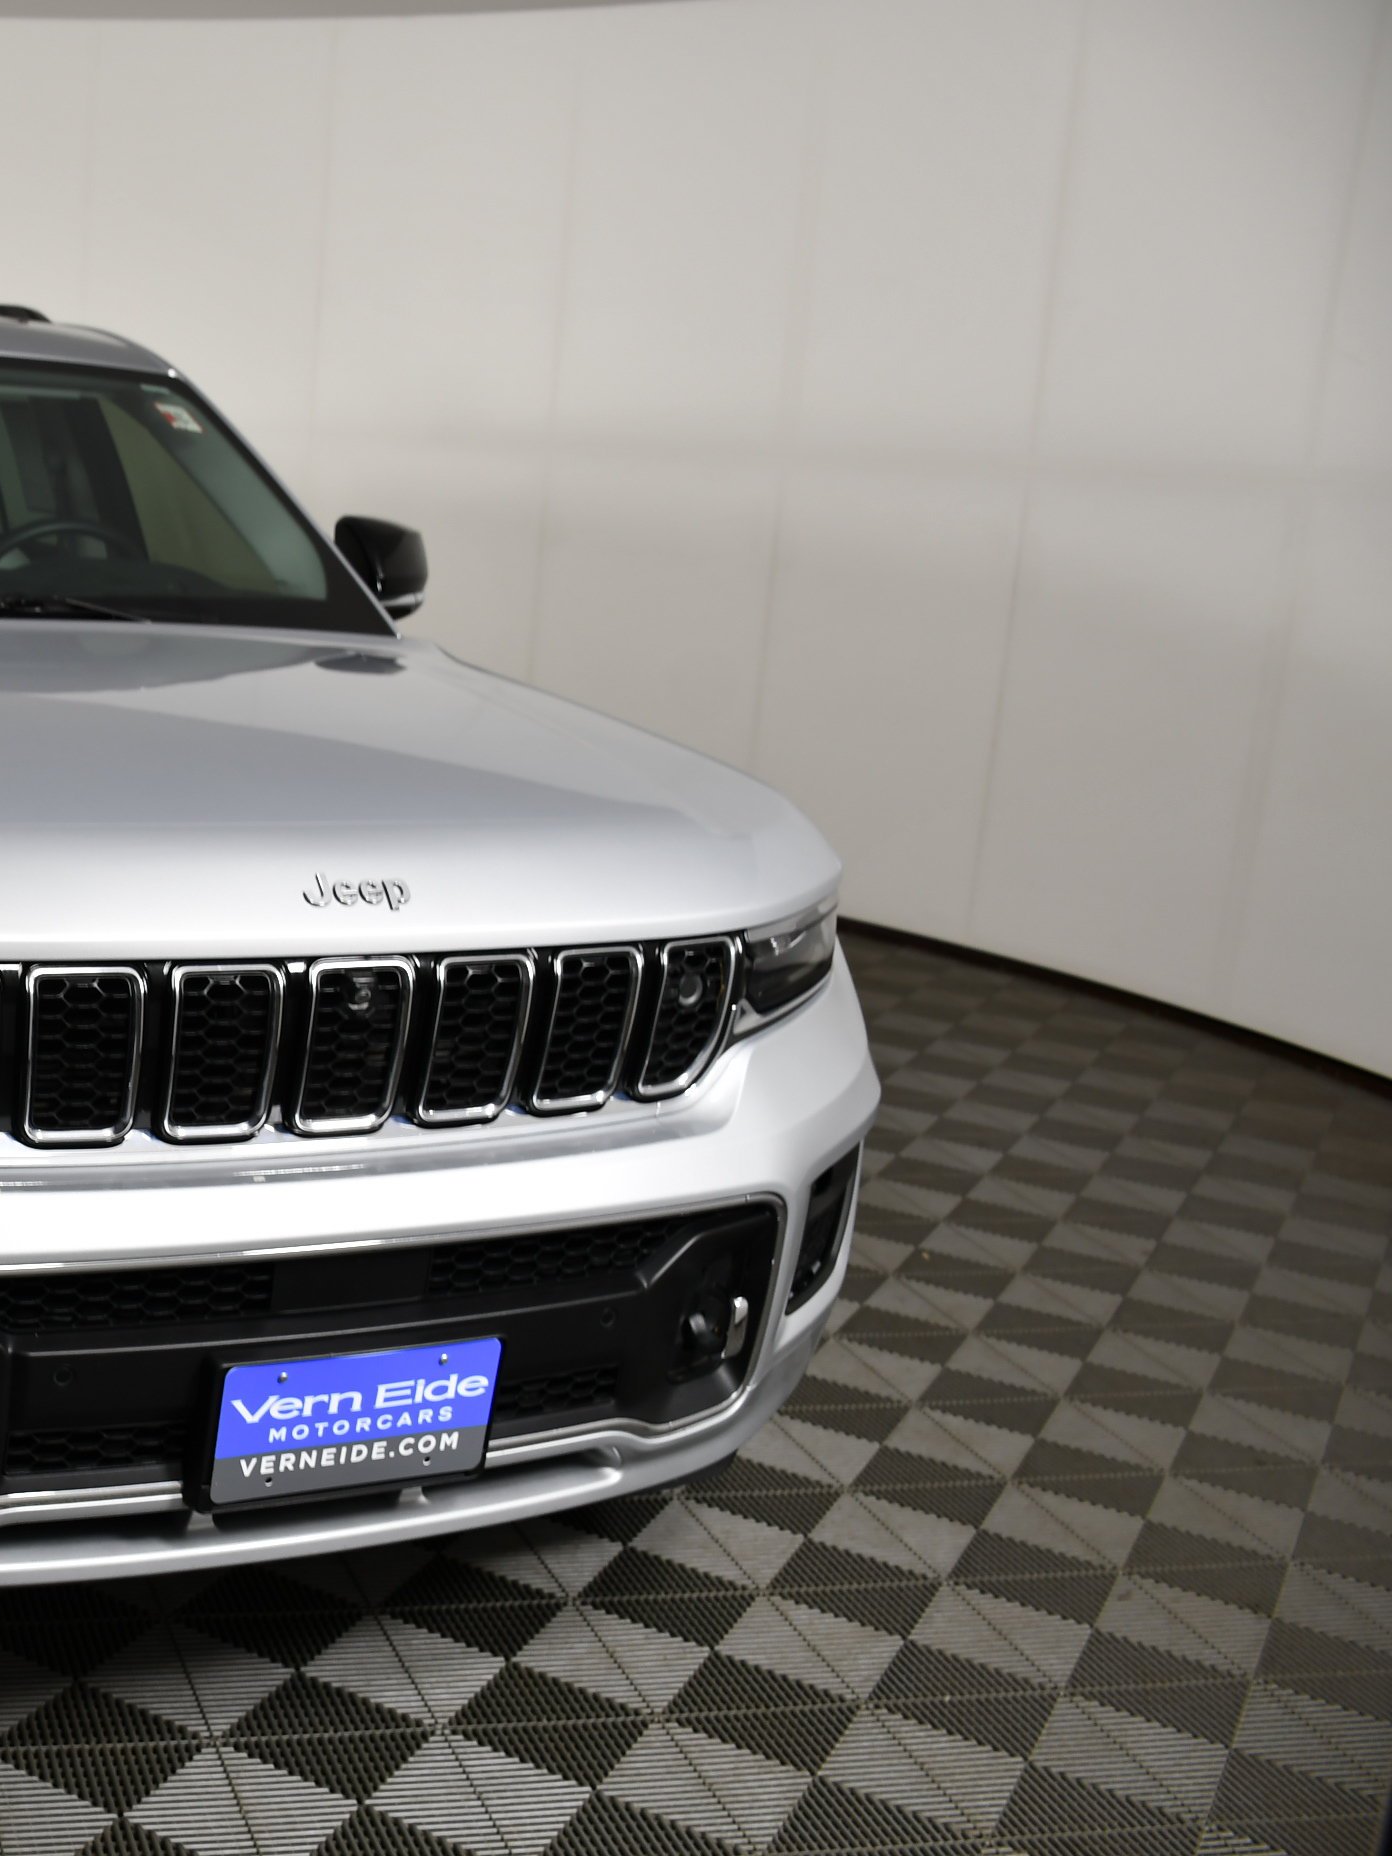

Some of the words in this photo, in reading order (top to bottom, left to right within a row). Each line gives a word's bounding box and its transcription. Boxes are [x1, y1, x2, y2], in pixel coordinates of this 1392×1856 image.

[302, 871, 411, 912] Jeep
[230, 1389, 363, 1424] Vern
[373, 1373, 490, 1410] Eide
[268, 1405, 454, 1444] MOTORCARS
[239, 1431, 460, 1478] VERNEIDE.COM
